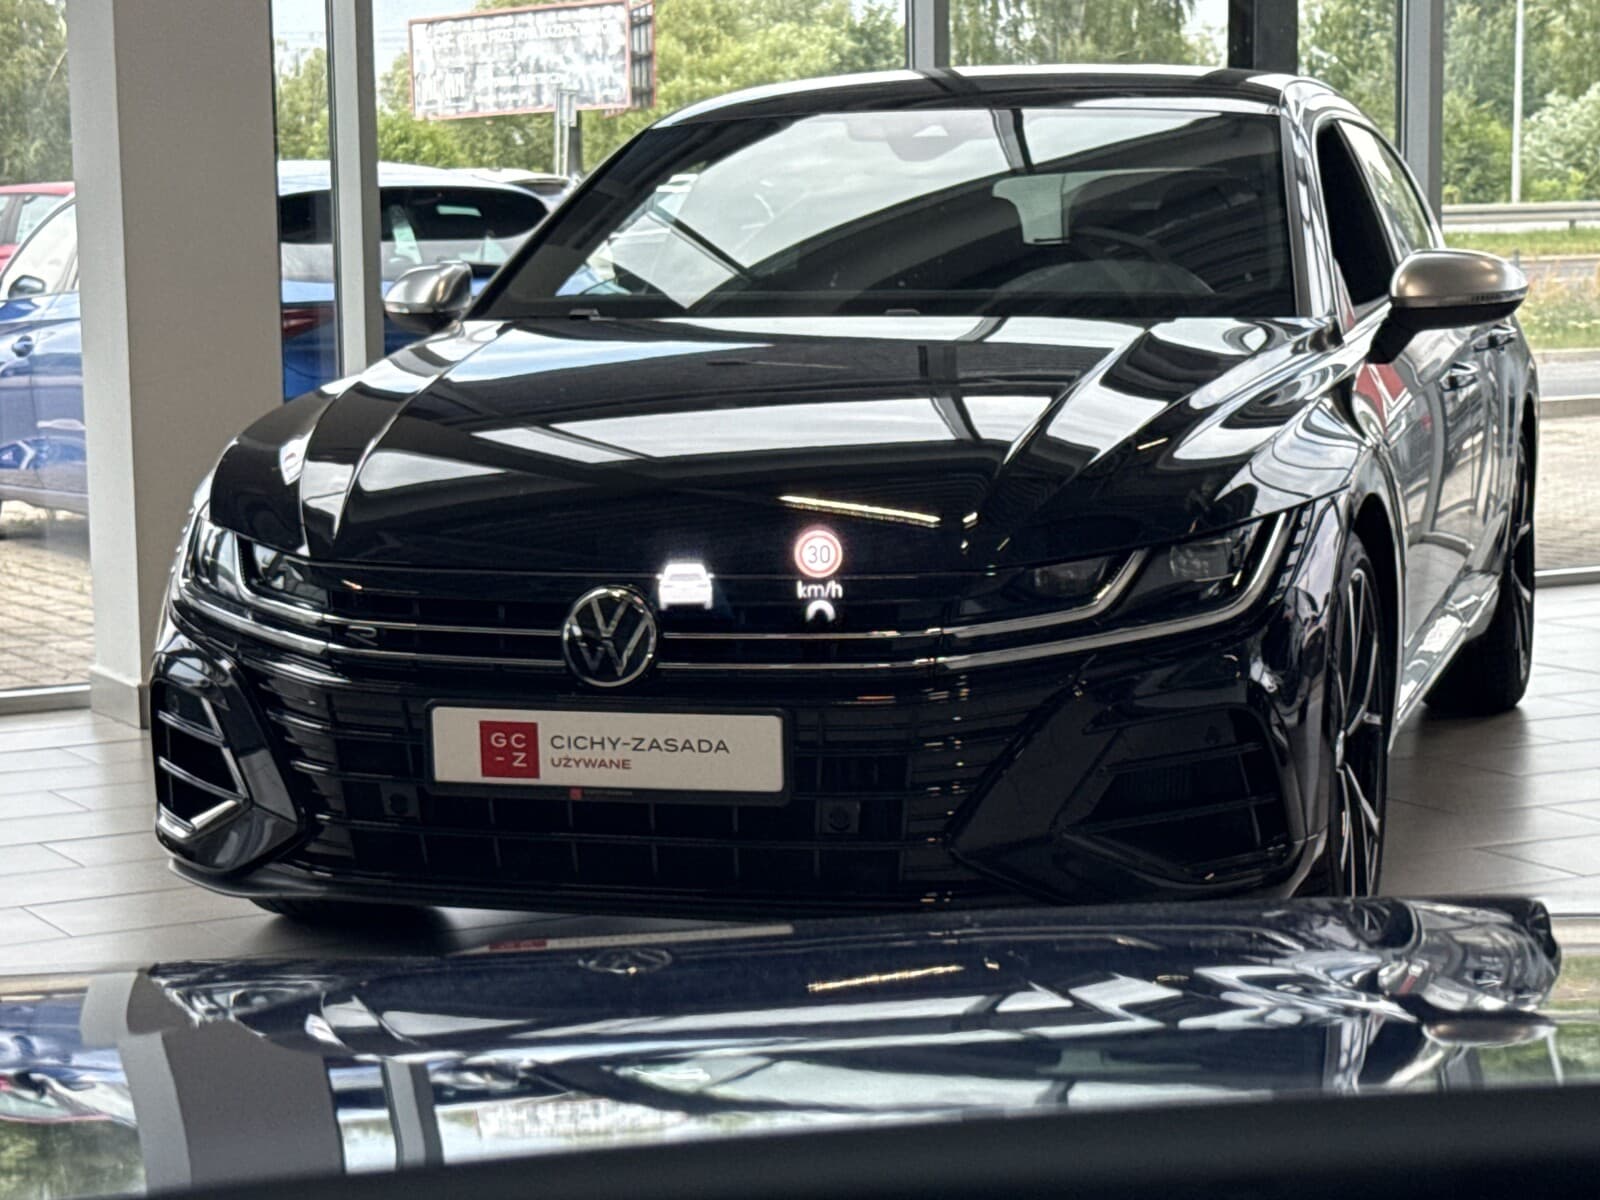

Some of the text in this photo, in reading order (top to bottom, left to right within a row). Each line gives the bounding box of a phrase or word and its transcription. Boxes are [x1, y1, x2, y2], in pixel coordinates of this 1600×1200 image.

[807, 544, 831, 564] 30
[796, 580, 843, 599] km/h
[490, 732, 528, 748] GC
[550, 735, 730, 754] CICHY-ZASADA
[550, 755, 632, 770] UŻYWANE
